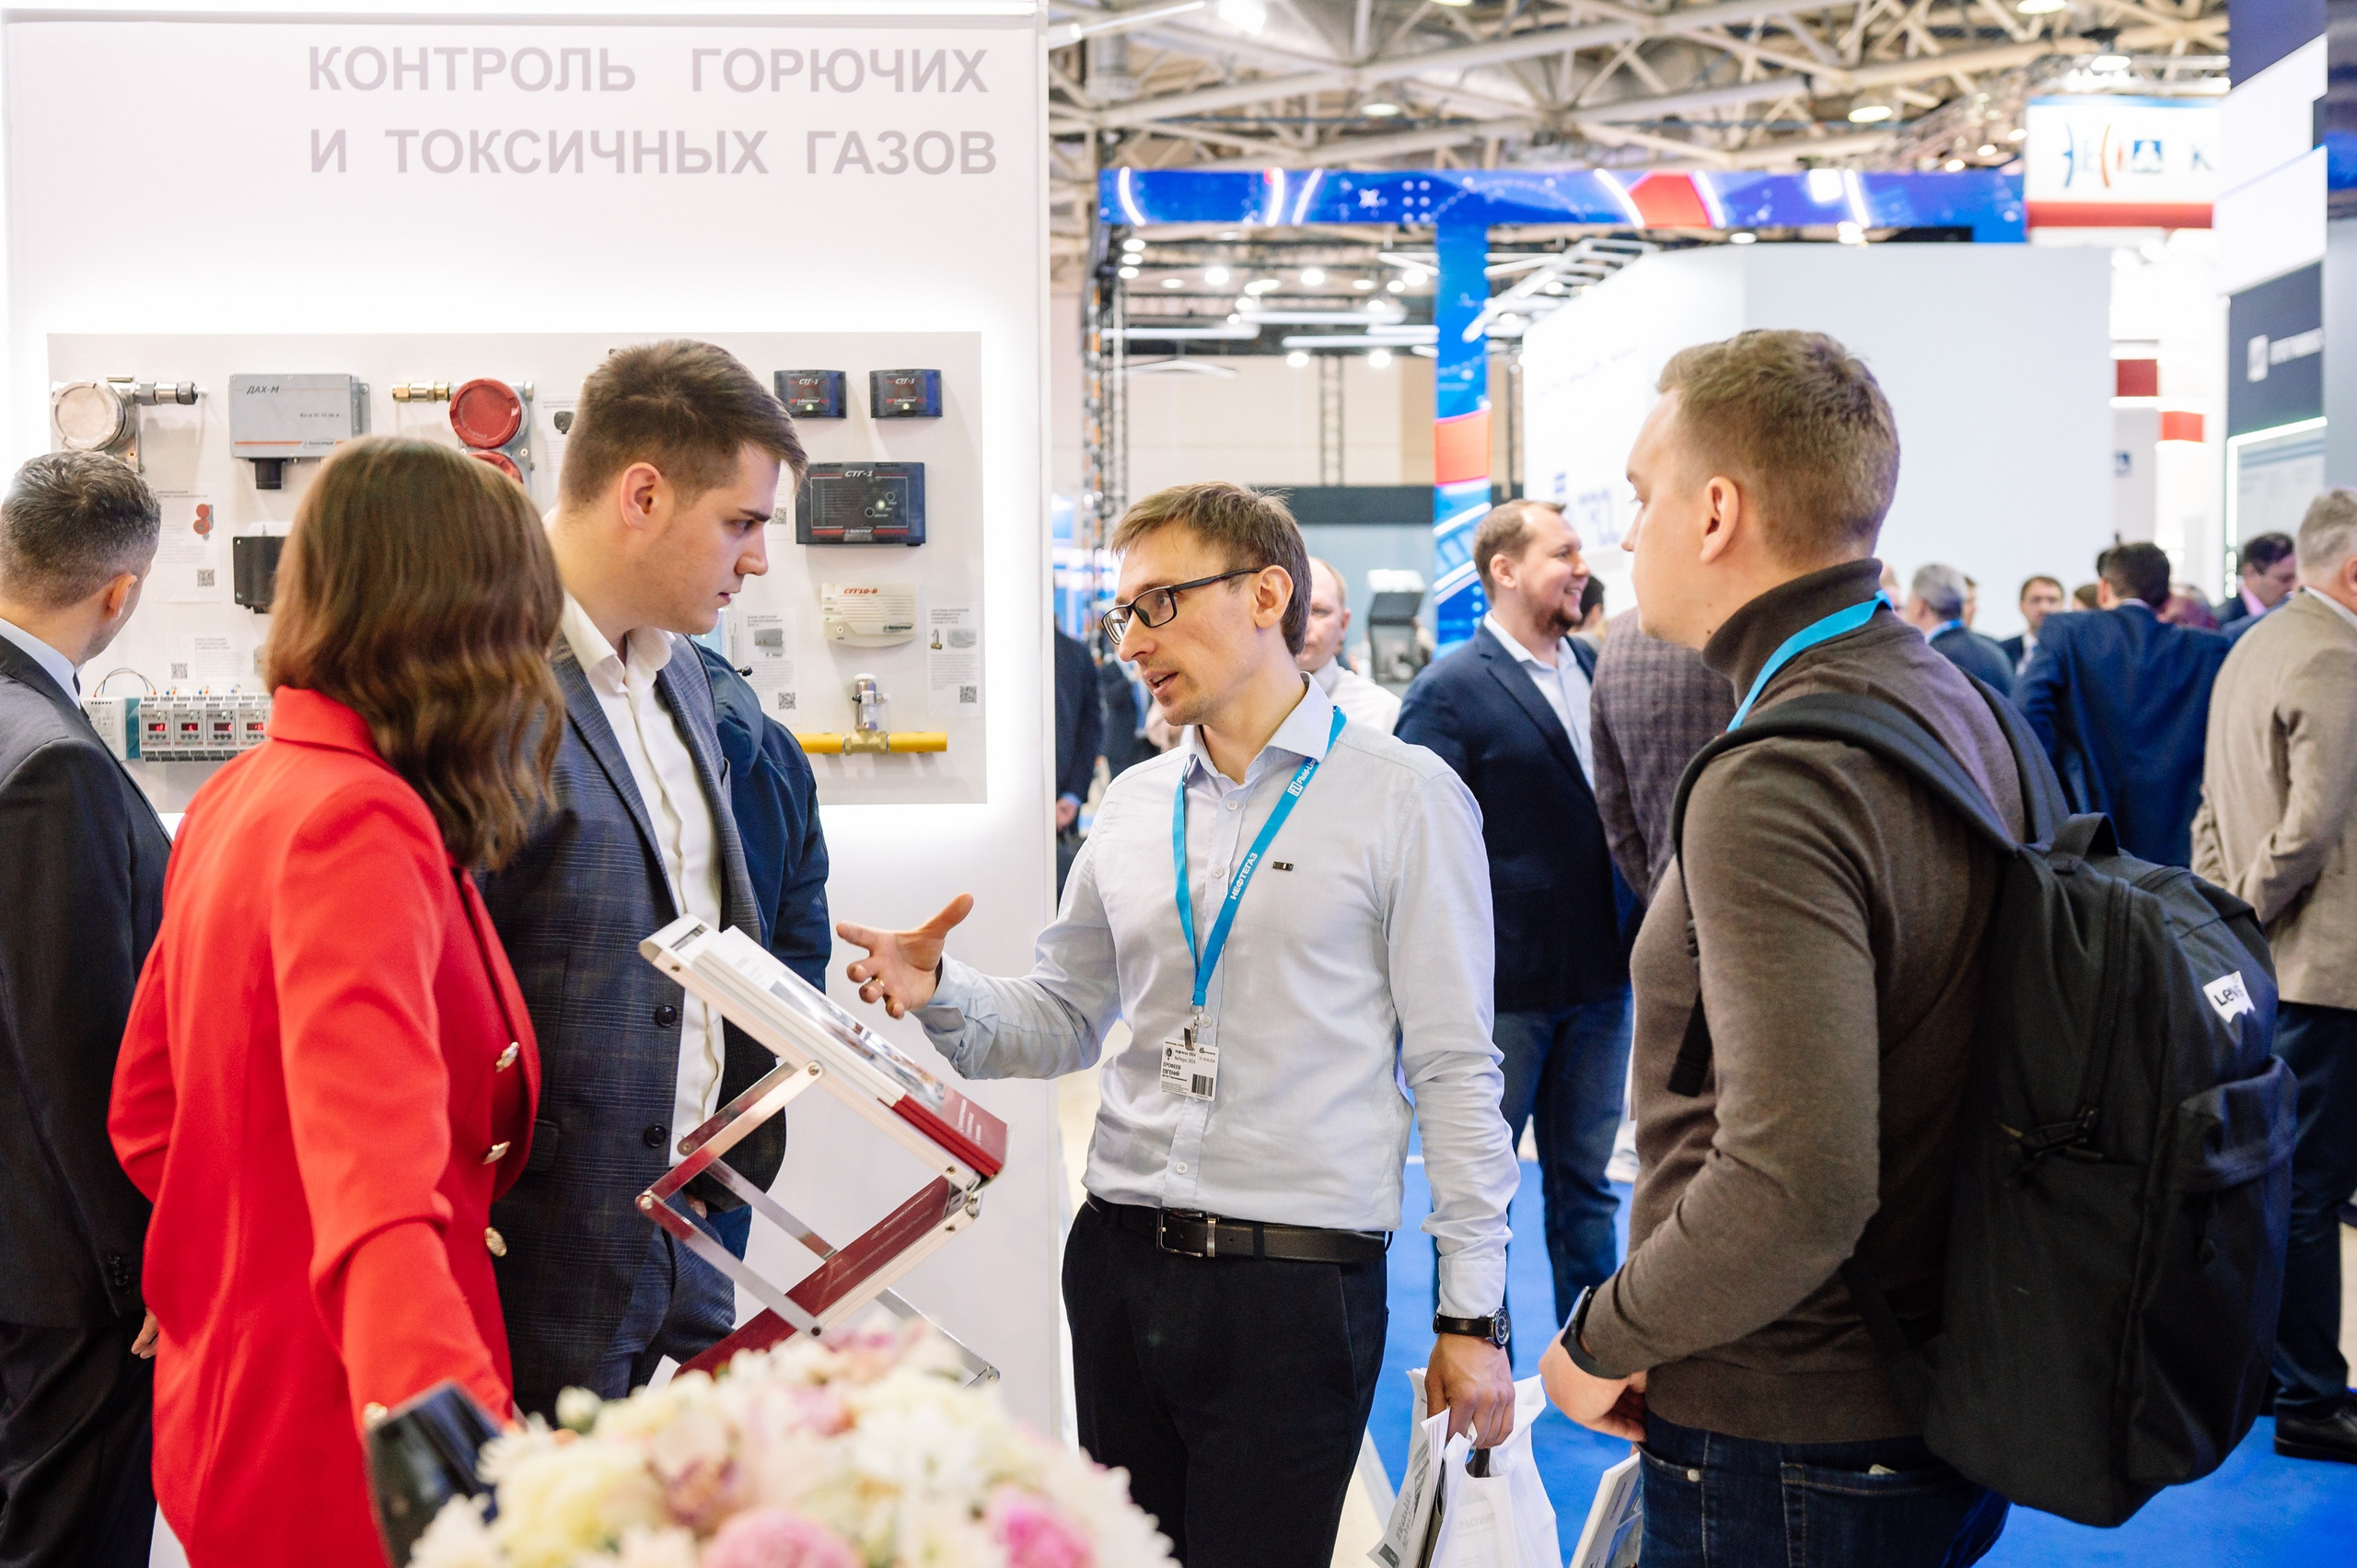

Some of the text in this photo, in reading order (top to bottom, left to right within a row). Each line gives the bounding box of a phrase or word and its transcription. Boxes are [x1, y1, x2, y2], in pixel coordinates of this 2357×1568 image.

[308, 45, 990, 93] КОНТРОЛЬ ГОРЮЧИХ
[310, 128, 997, 175] И ТОКСИЧНЫХ ГАЗОВ
[1229, 852, 1259, 900] НЕФТЕГАЗ
